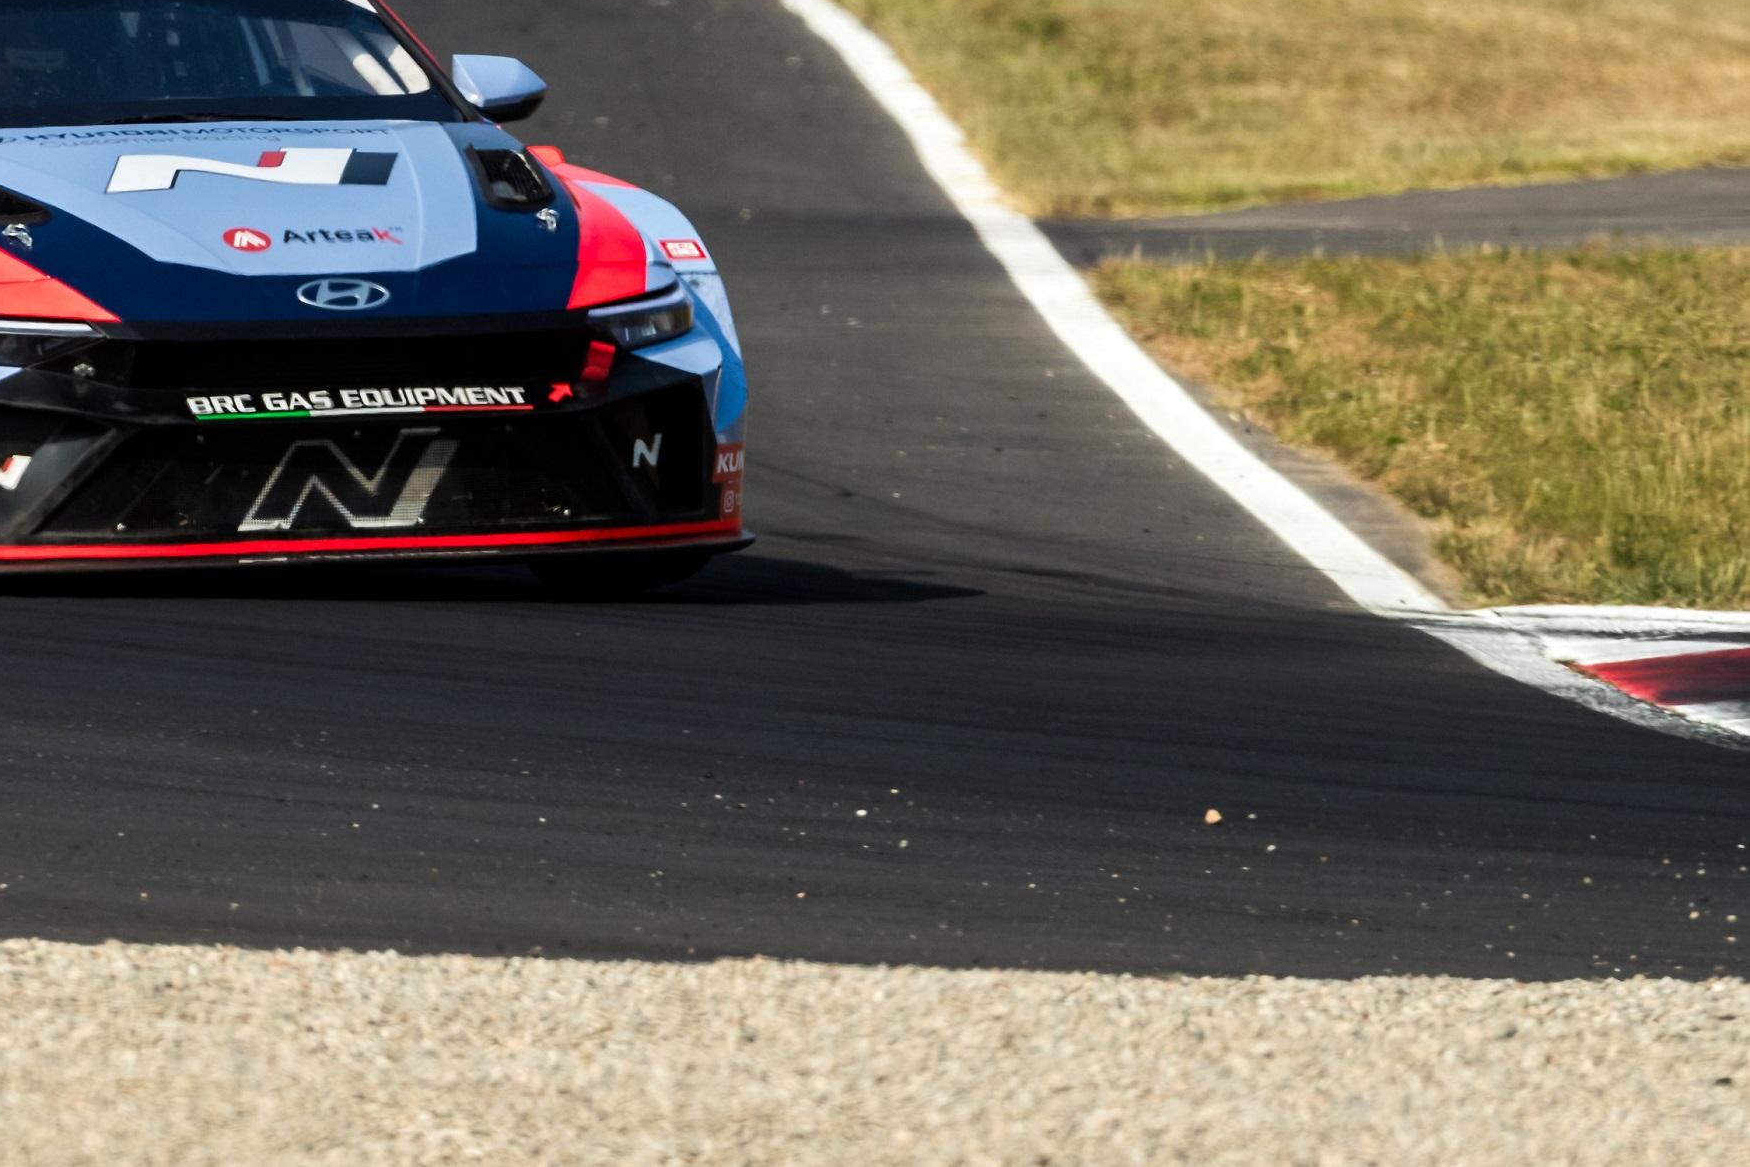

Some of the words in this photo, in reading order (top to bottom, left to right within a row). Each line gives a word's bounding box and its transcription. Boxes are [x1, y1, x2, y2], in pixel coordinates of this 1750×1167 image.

[187, 394, 256, 415] BRC
[262, 390, 335, 411] GAS
[340, 386, 526, 408] EQUIPMENT
[632, 433, 663, 469] N
